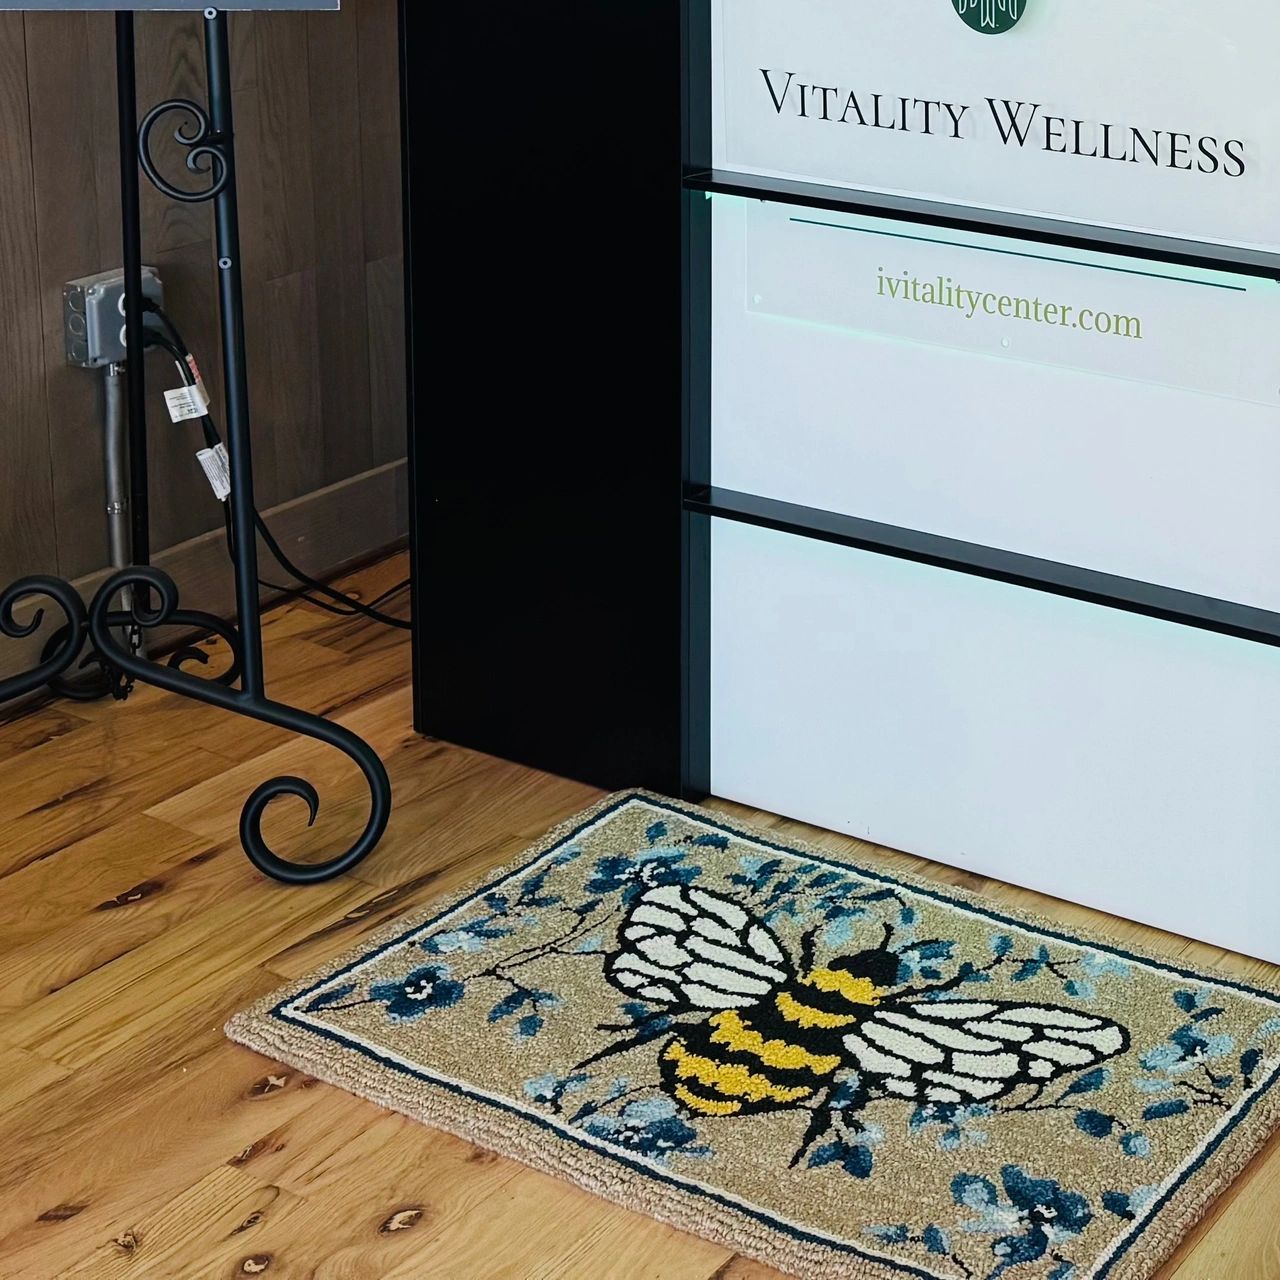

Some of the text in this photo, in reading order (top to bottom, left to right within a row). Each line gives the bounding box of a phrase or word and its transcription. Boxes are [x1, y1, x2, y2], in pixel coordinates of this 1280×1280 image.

[758, 68, 1246, 178] VITALITY WELLNESS
[876, 266, 1143, 339] ivitalitycenter.com
